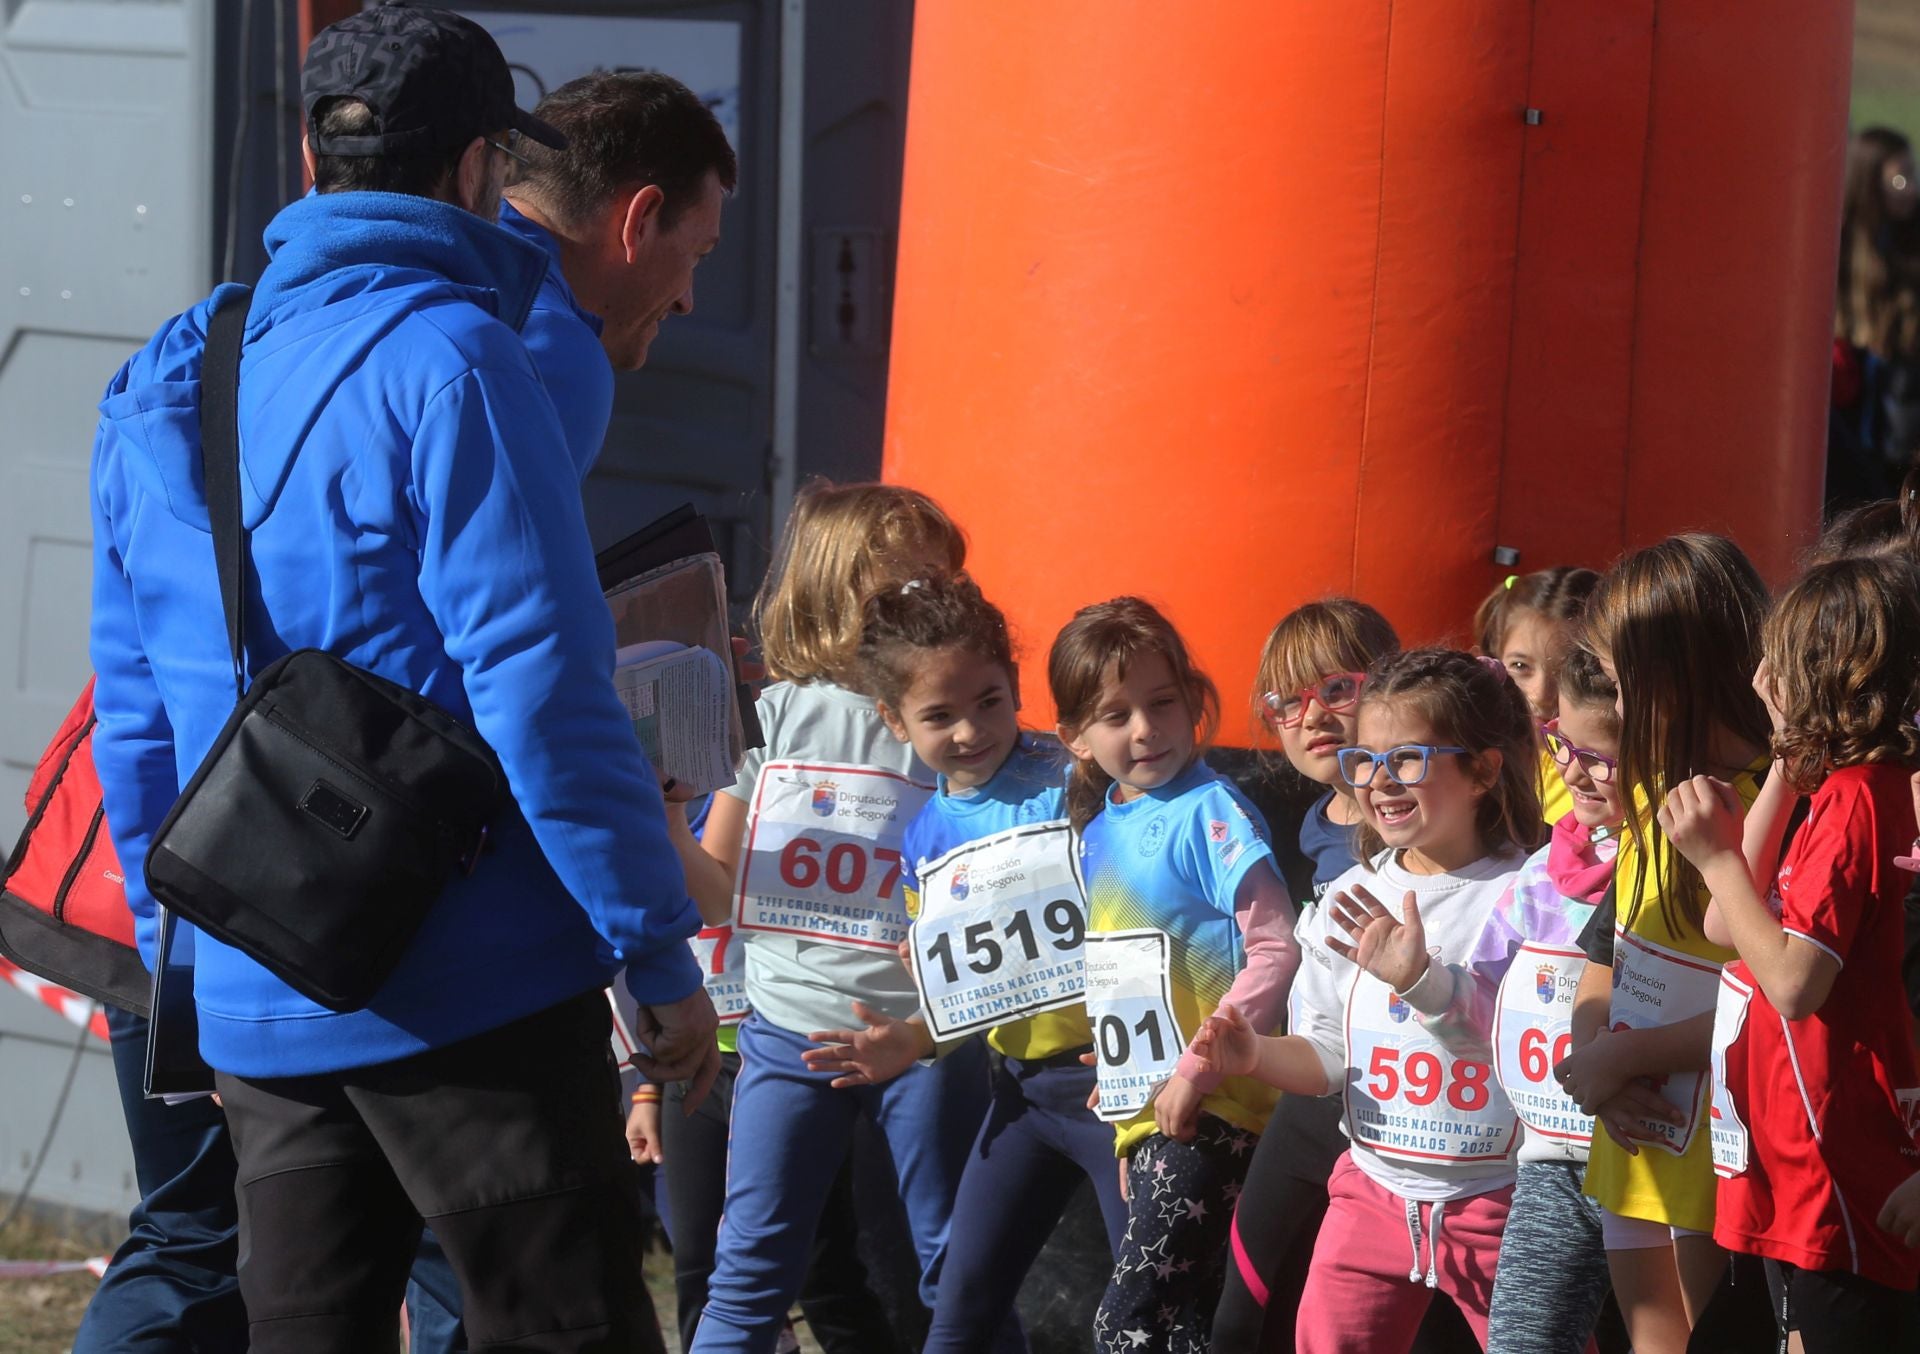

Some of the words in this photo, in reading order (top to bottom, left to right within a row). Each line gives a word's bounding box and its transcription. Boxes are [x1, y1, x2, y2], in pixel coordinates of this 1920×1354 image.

[840, 791, 899, 807] Diputación
[837, 807, 851, 817] de
[855, 808, 896, 821] Segovia
[780, 838, 901, 899] 607
[972, 883, 984, 894] de
[986, 872, 1025, 890] Segovia
[757, 896, 783, 908] LIII
[787, 899, 828, 913] CROSS
[833, 905, 902, 925] NACIONAL
[759, 911, 869, 937] CANTIMPALOS
[697, 925, 733, 975] 7
[927, 899, 1086, 984] 1519
[941, 994, 963, 1008] LIII
[966, 982, 1005, 1002] CROSS
[1007, 963, 1073, 990] NACIONAL
[1624, 964, 1666, 991] Diputación
[949, 986, 1049, 1025] CANTIMPALOS
[1557, 993, 1571, 1003] de
[1621, 980, 1630, 992] de
[1631, 985, 1662, 1007] Segovia
[1088, 1010, 1165, 1067] 01
[1368, 1046, 1490, 1111] 598
[1510, 1090, 1525, 1104] LIII
[1528, 1094, 1557, 1110] CROSS
[1562, 1101, 1581, 1113] NA
[1357, 1109, 1374, 1123] LIII
[1376, 1112, 1408, 1128] CROSS
[1411, 1118, 1482, 1137] NACIONAL
[1487, 1127, 1502, 1138] DE
[1360, 1126, 1446, 1151] CANTIMPALOS
[1460, 1141, 1494, 1154] 2025
[1721, 1149, 1738, 1165] 2025
